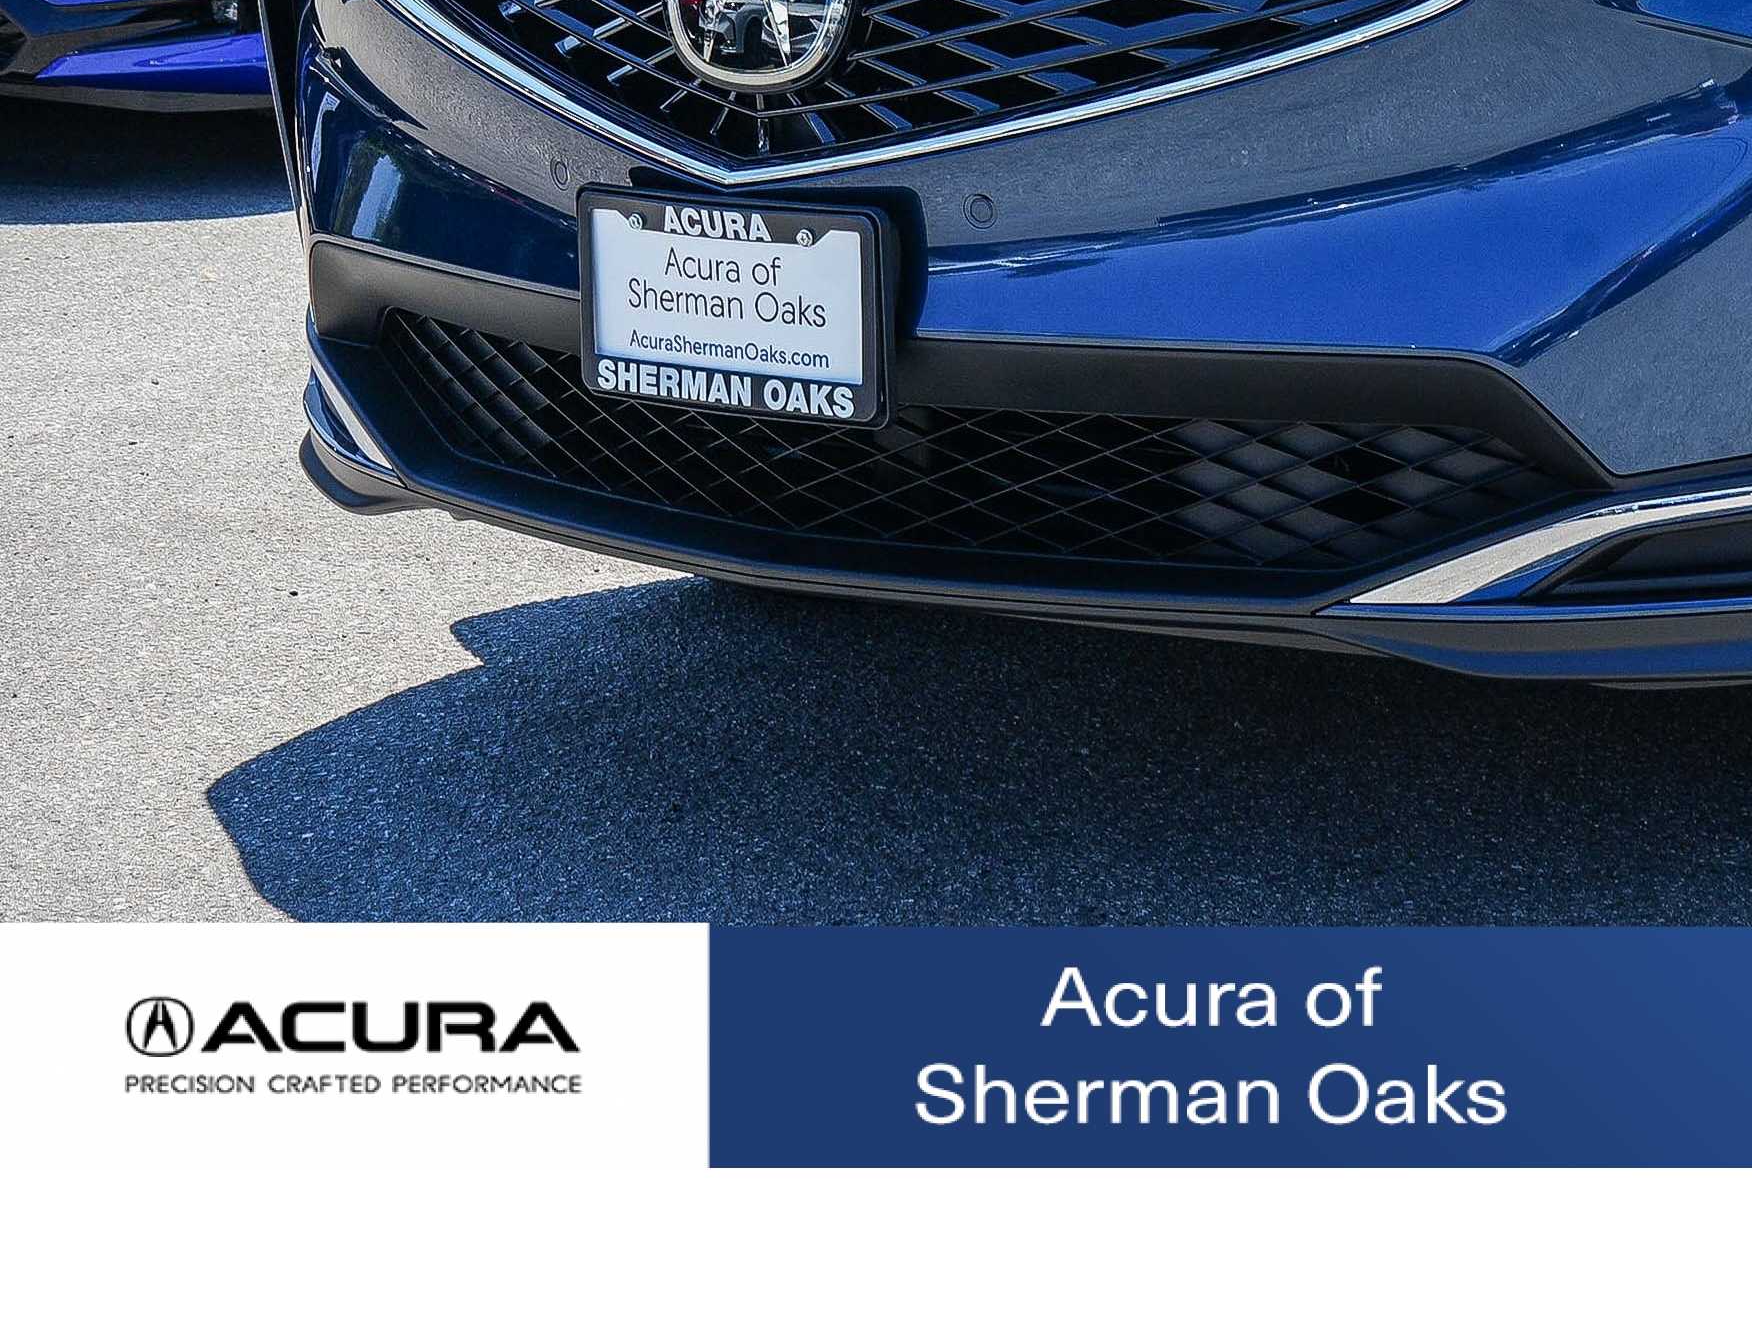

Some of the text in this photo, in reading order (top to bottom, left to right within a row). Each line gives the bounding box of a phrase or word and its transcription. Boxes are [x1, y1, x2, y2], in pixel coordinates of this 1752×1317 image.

[663, 205, 772, 243] ACURA
[663, 246, 782, 288] Acura of
[627, 277, 827, 329] Sherman Oaks
[628, 328, 830, 370] AcuraShermanOaks.com
[597, 358, 856, 419] SHERMAN OAKS
